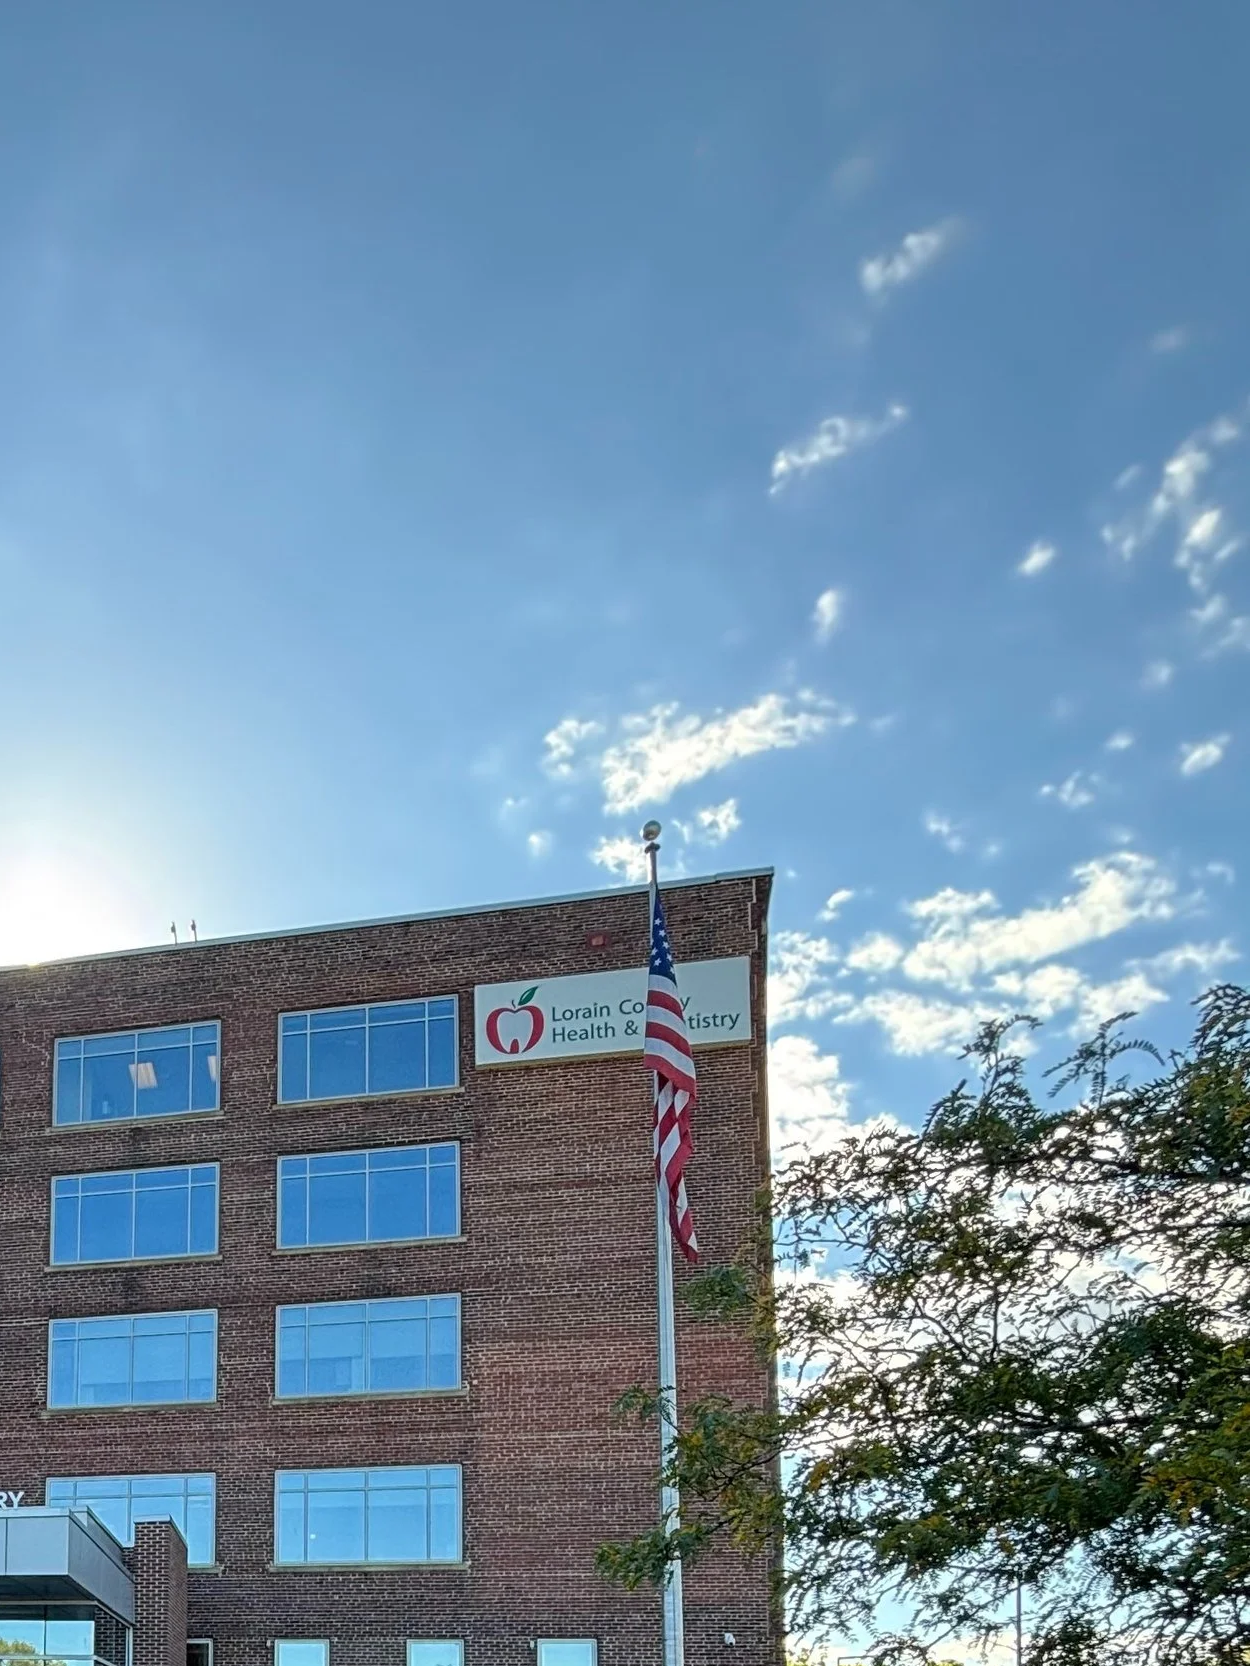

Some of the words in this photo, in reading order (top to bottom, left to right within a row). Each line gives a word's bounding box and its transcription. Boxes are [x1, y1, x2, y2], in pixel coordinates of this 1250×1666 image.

[552, 1002, 610, 1022] Lorain
[619, 996, 691, 1015] Coy
[552, 1022, 616, 1043] Health
[624, 1020, 639, 1036] &
